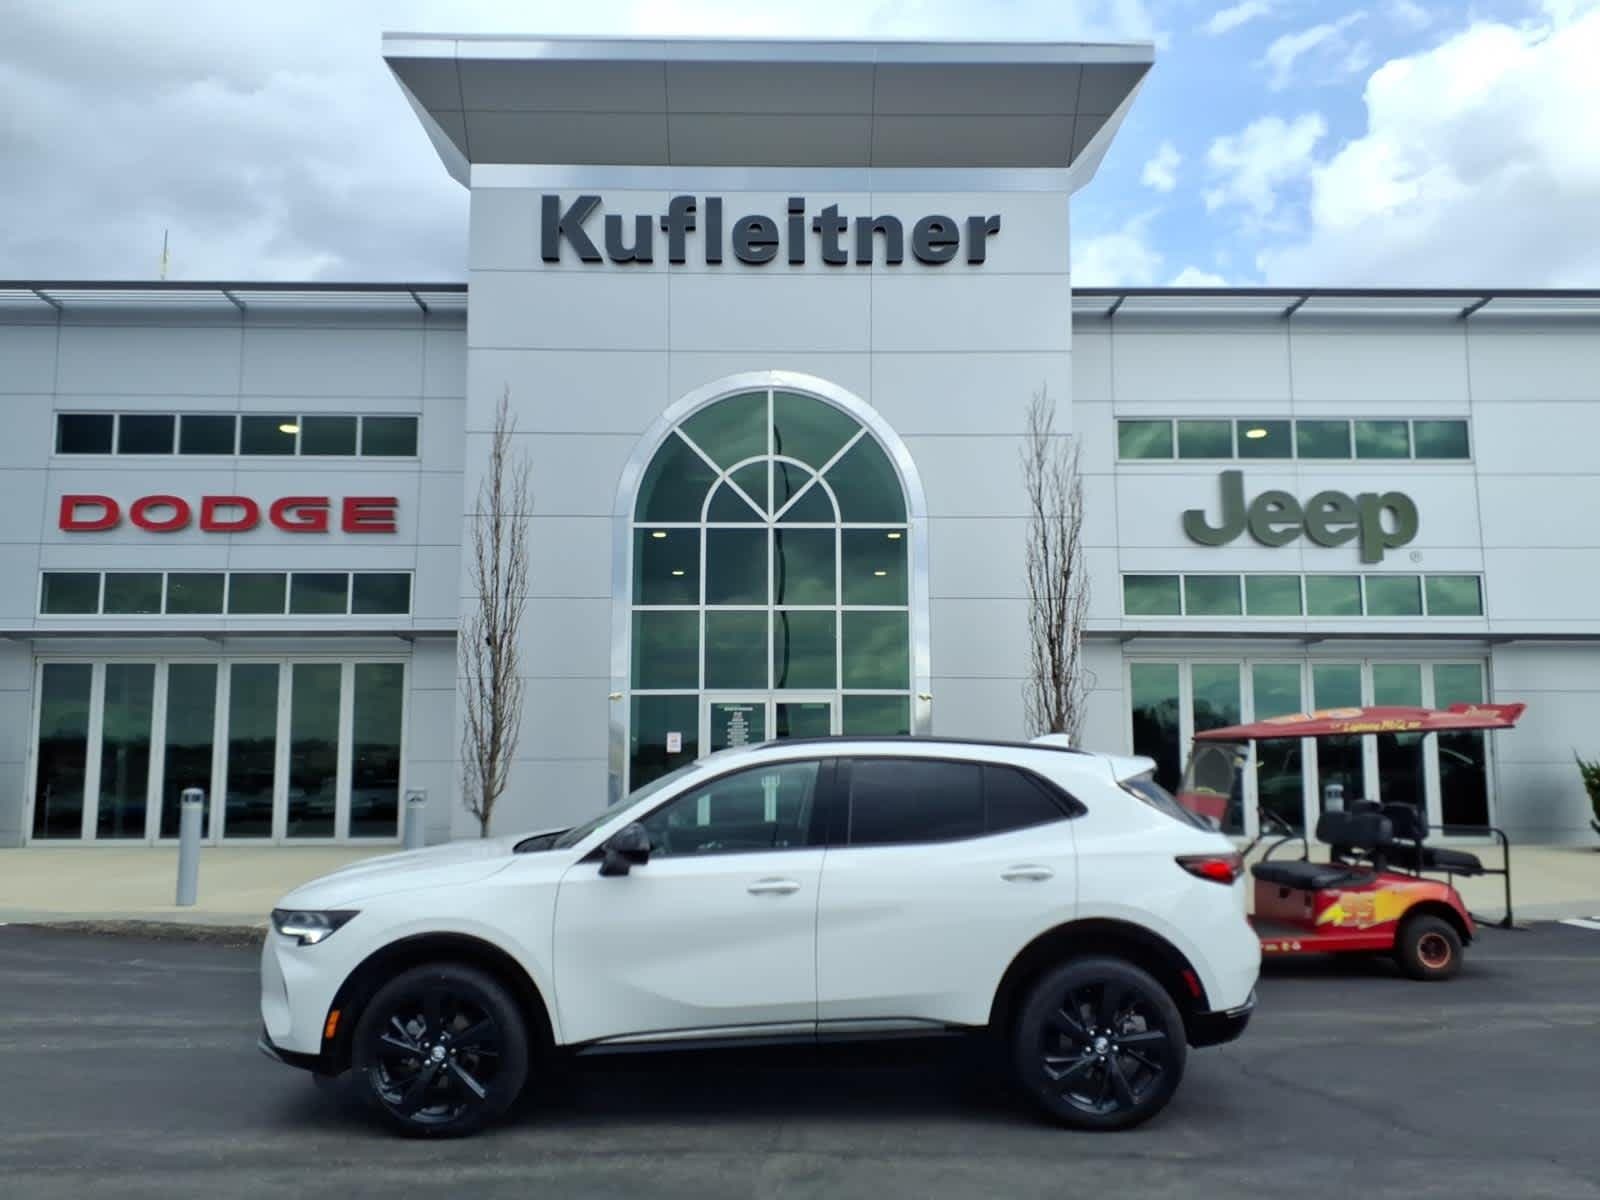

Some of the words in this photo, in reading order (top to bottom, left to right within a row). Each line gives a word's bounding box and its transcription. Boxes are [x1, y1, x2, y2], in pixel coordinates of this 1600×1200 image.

[541, 194, 1001, 265] Kufleitner
[58, 494, 398, 533] DODGE
[1183, 470, 1419, 564] Jeep
